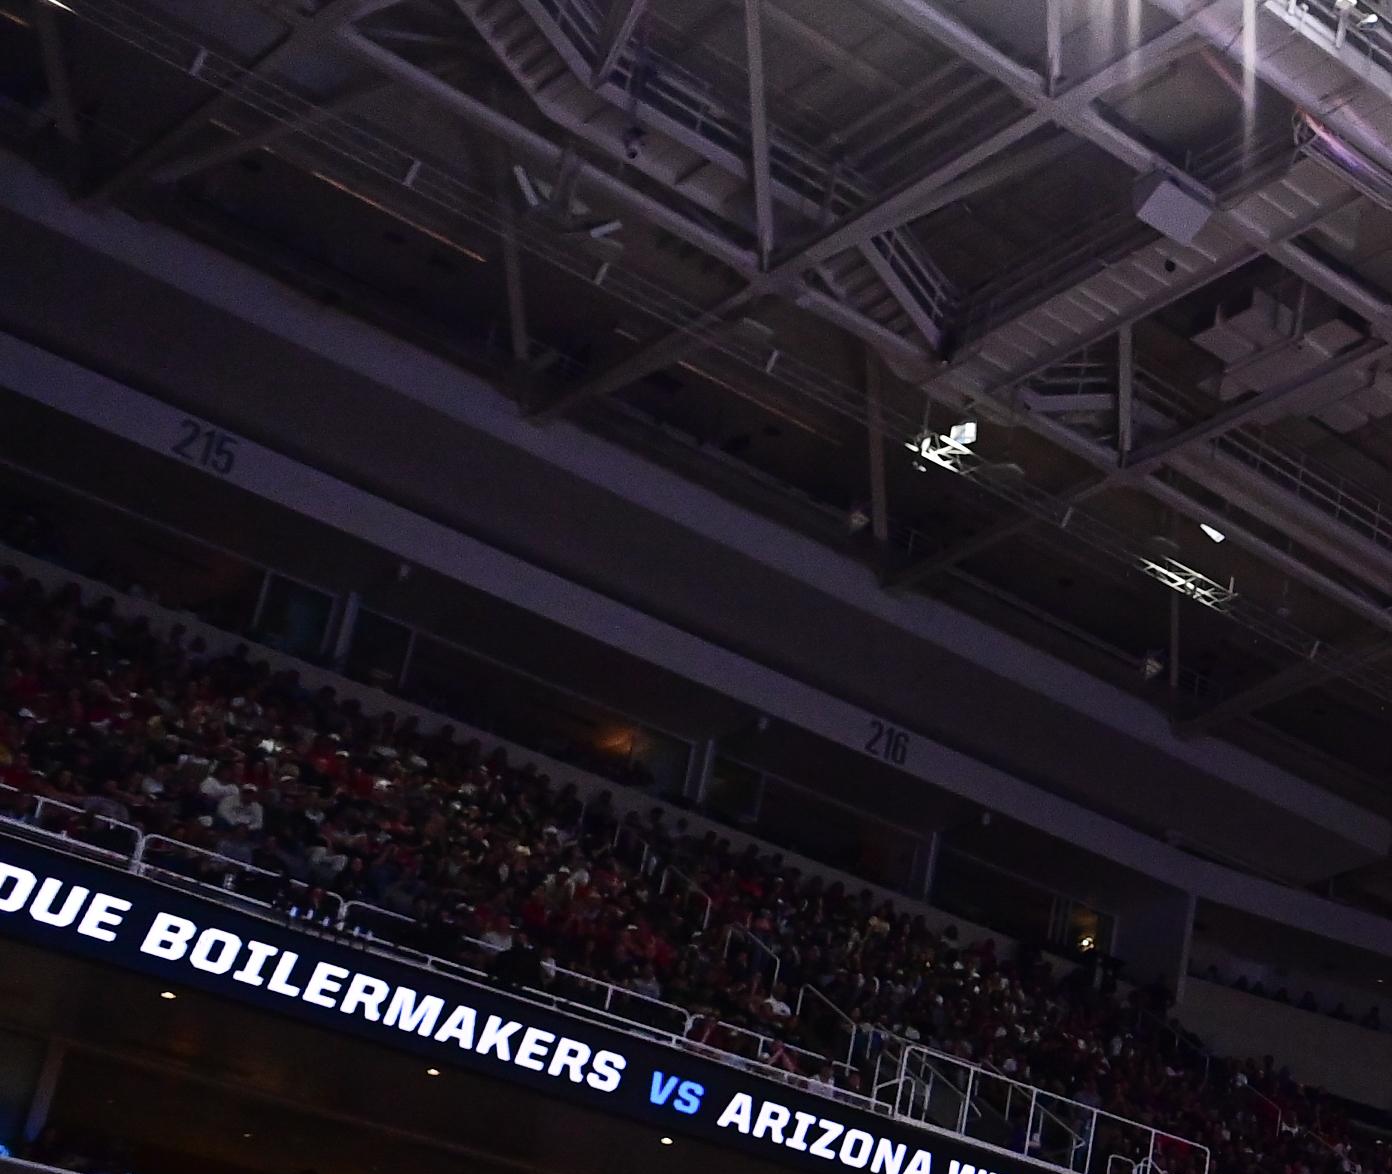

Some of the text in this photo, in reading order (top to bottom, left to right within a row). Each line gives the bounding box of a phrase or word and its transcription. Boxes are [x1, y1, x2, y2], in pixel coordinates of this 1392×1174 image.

[172, 420, 236, 475] 215
[865, 721, 909, 765] 216
[0, 862, 133, 943] DUE
[140, 912, 627, 1092] BOILERMAKERS
[650, 1071, 705, 1115] VS
